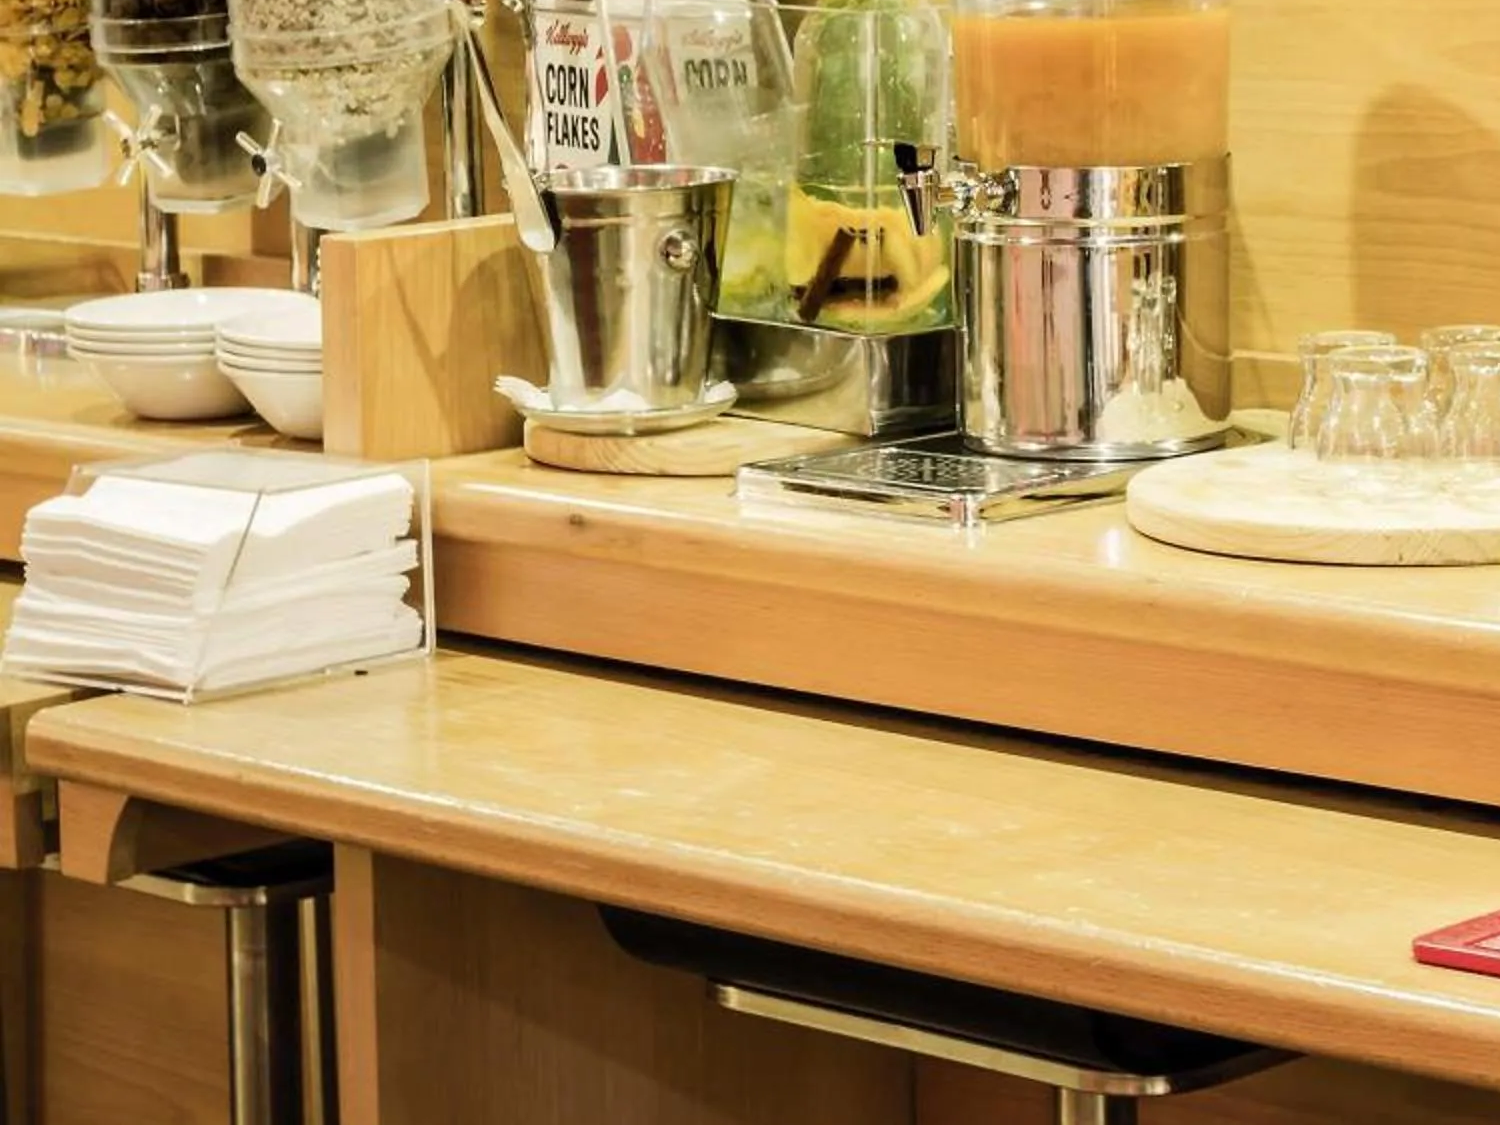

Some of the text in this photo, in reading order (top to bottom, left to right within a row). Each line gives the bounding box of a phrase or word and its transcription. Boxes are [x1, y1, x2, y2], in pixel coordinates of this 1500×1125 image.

[546, 18, 589, 56] Kellogg's
[545, 63, 590, 109] CORN
[547, 111, 600, 152] FLAKES
